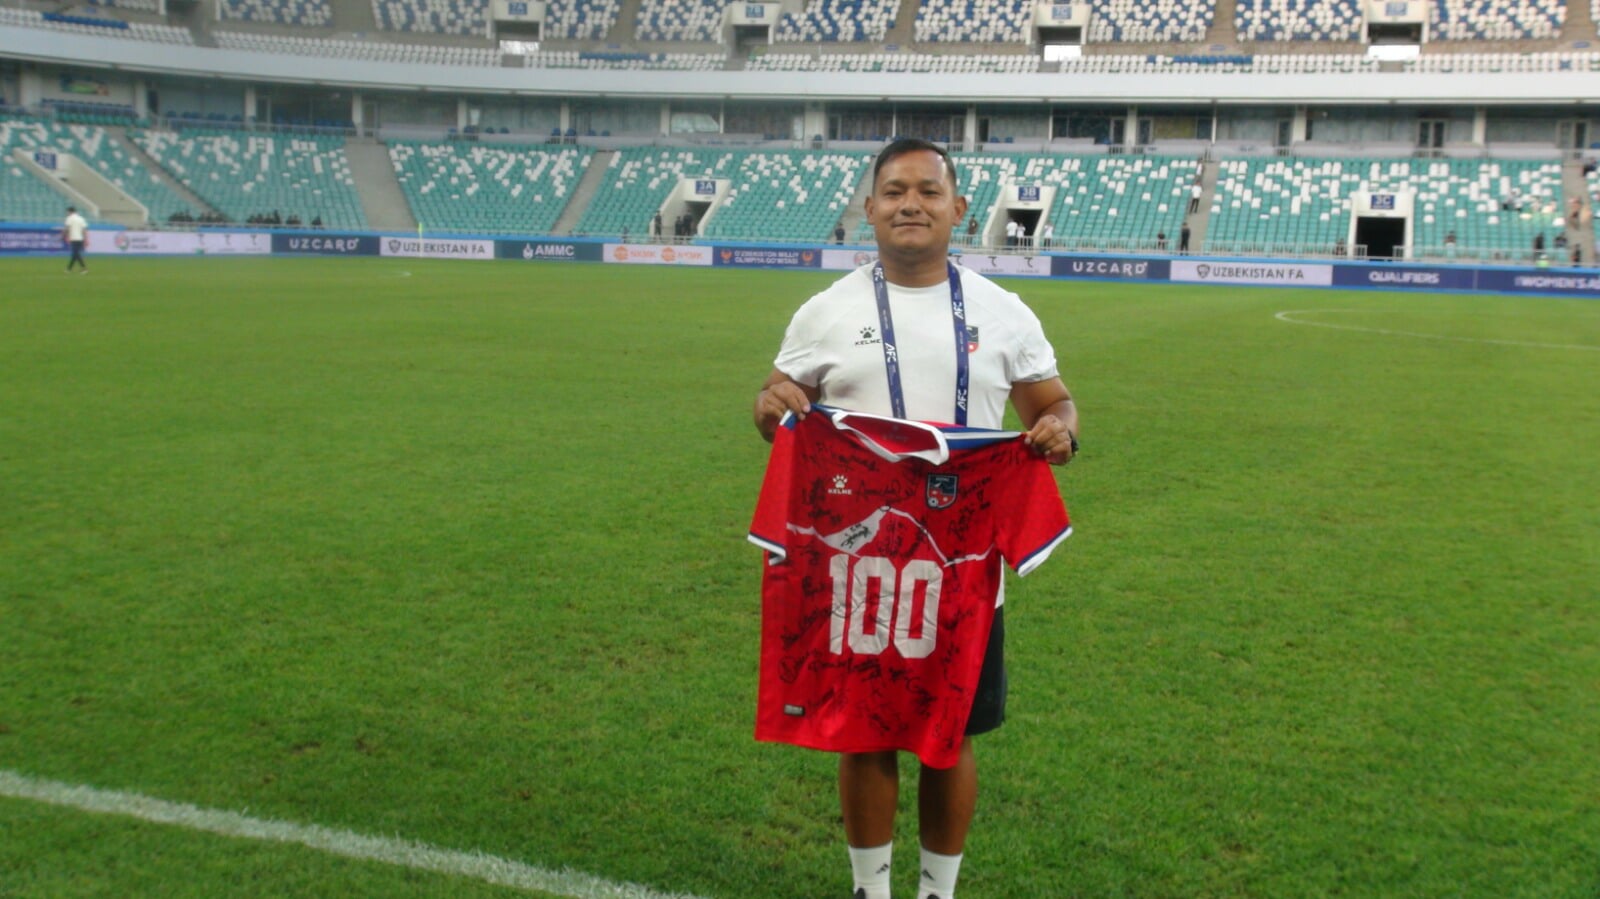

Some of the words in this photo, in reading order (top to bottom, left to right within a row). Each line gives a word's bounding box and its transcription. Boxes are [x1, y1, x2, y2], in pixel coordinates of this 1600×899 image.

[289, 238, 359, 251] UZCARD
[471, 244, 485, 254] FA
[534, 244, 574, 256] AMMC
[1072, 261, 1148, 276] UZCARD
[1212, 266, 1284, 279] UZBEKISTAN
[1288, 268, 1304, 279] FA
[1368, 270, 1439, 284] QUALIFIERS
[953, 301, 965, 320] AFC
[884, 342, 897, 363] AFC
[957, 389, 967, 411] AFC
[829, 553, 943, 659] 100
